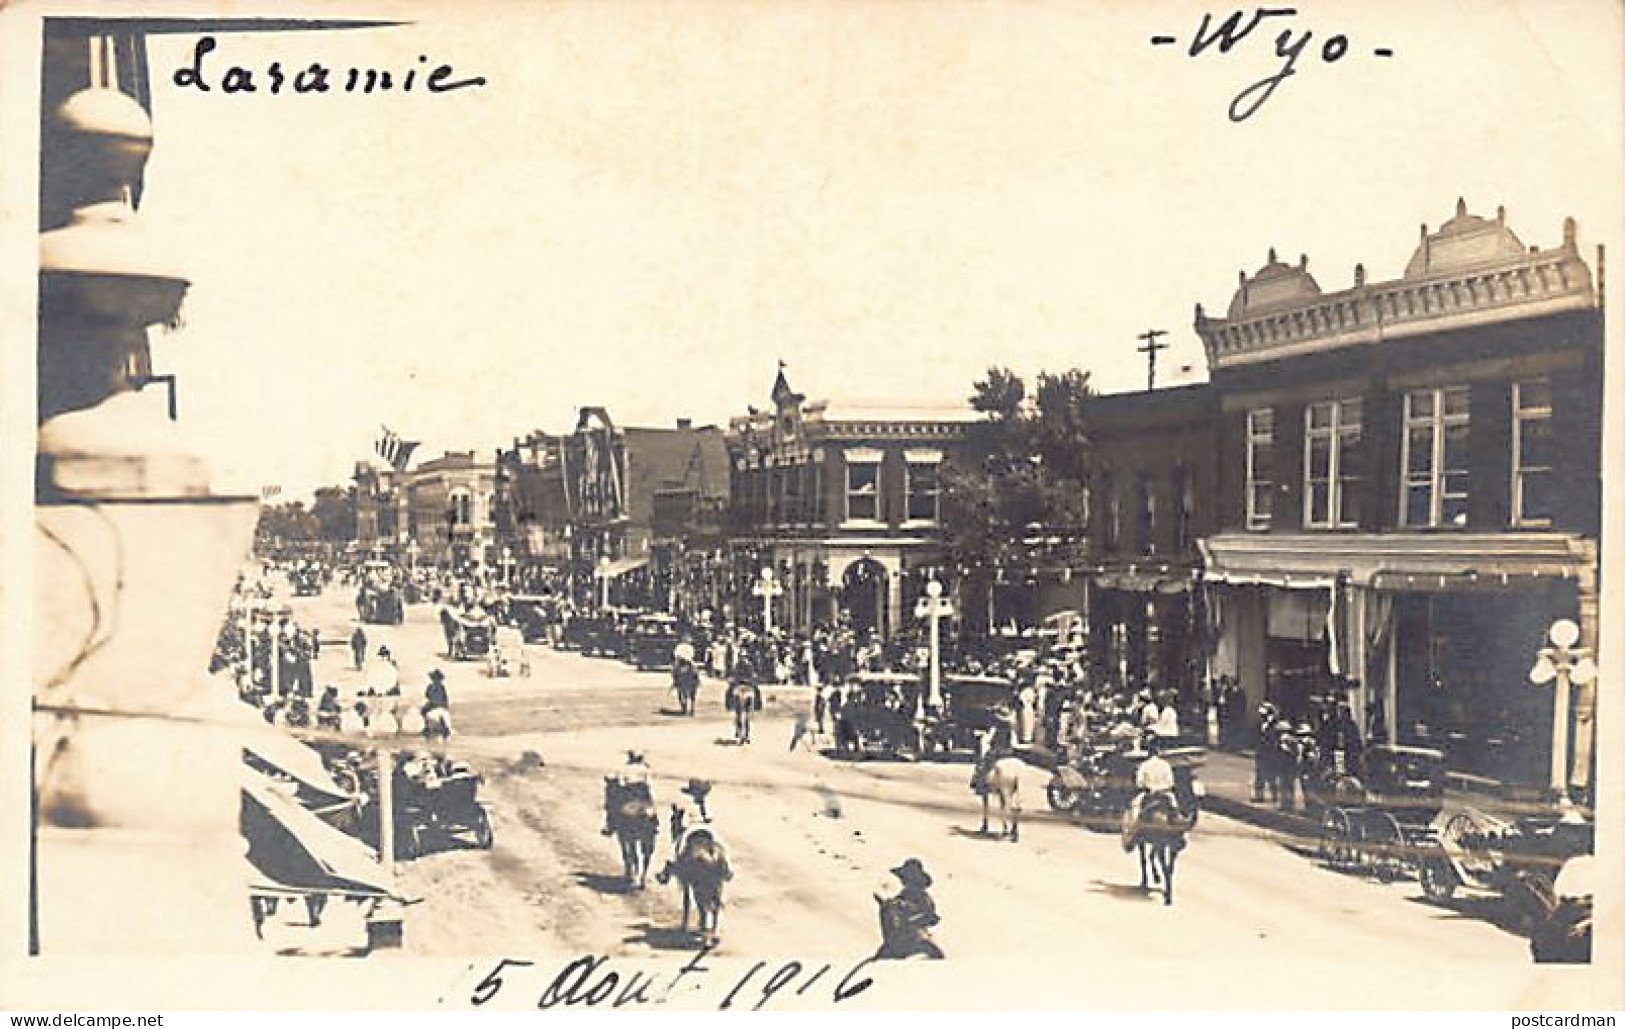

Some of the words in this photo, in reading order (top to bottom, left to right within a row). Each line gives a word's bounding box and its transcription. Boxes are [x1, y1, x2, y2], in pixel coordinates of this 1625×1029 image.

[173, 37, 486, 94] Laramie
[438, 960, 534, 1006] 5
[718, 958, 874, 1011] 1916
